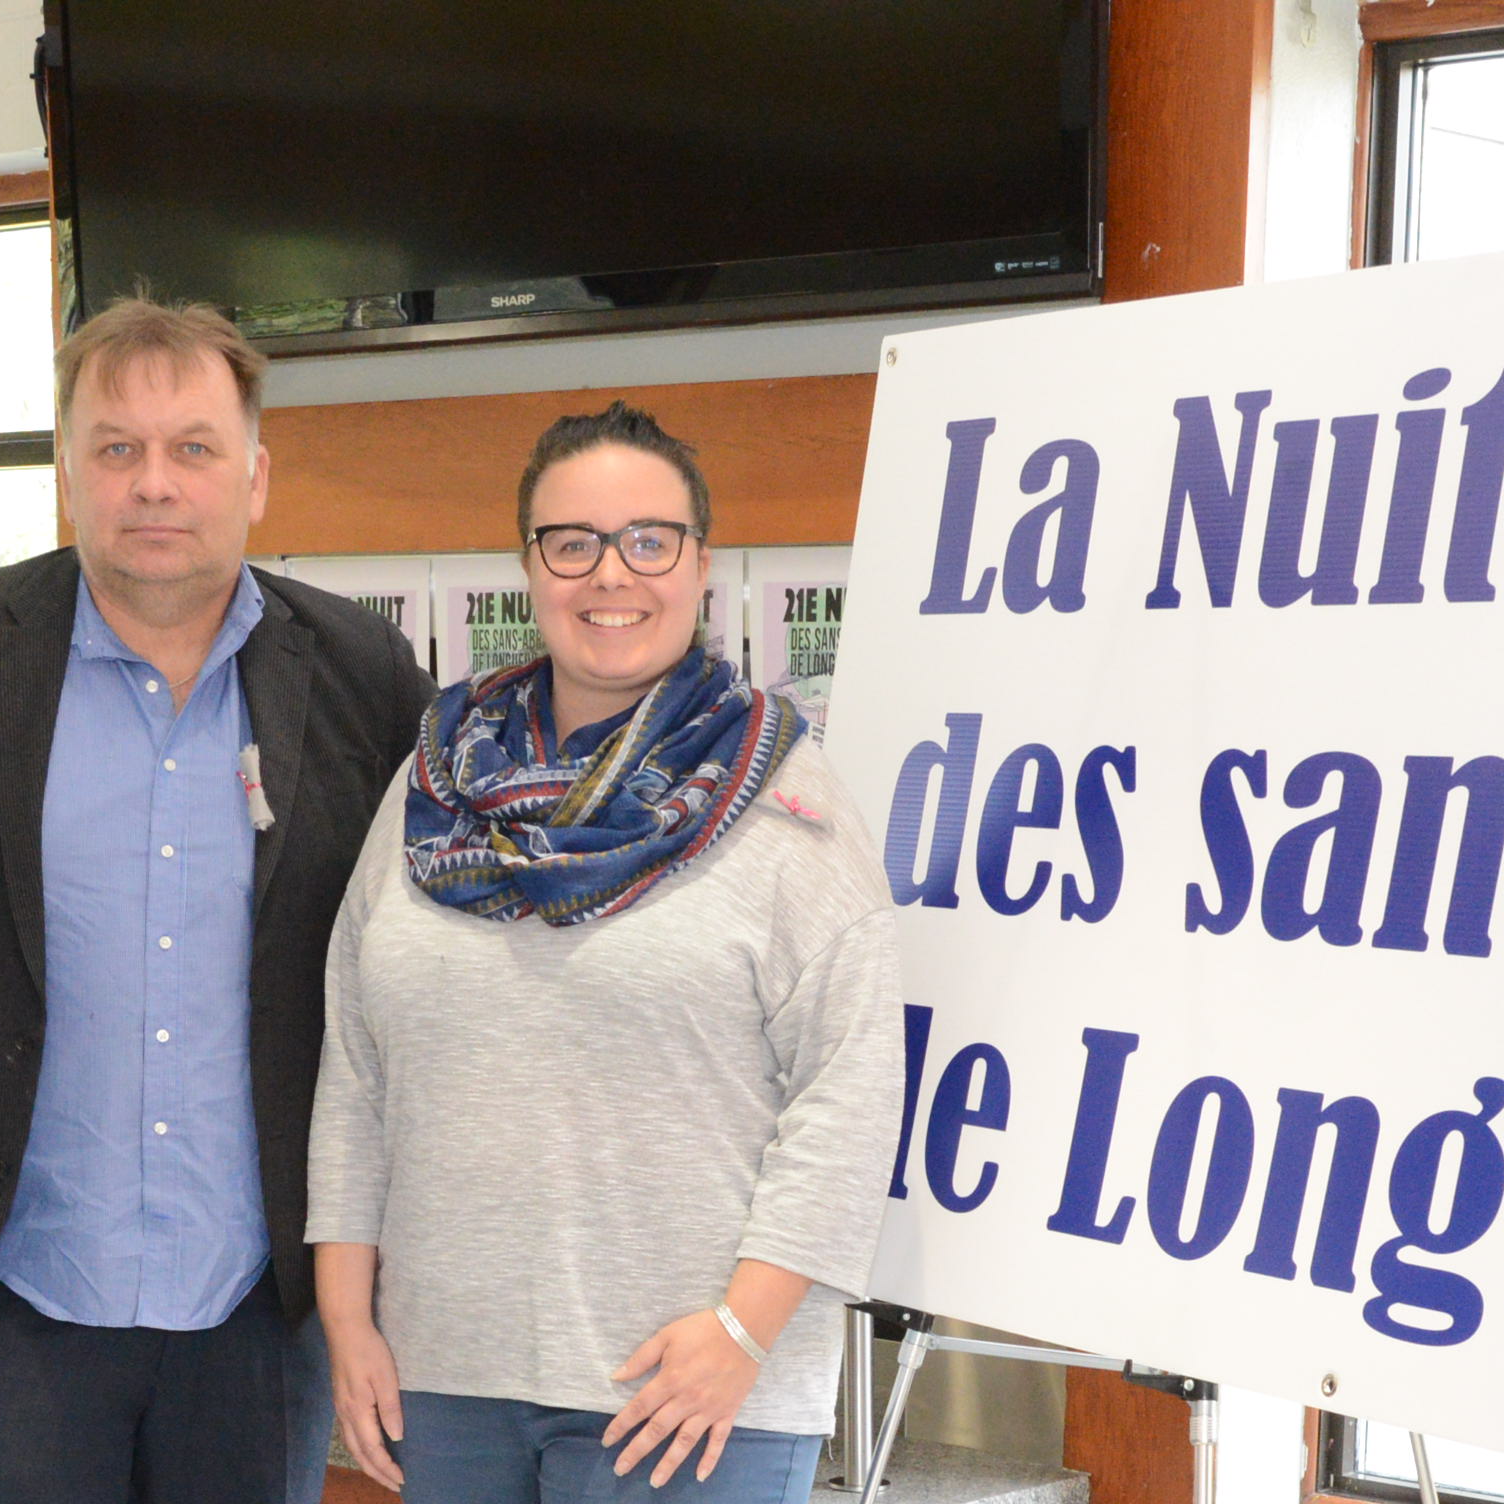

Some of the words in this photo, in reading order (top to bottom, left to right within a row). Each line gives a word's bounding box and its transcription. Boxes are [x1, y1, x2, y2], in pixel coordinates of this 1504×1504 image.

[491, 293, 535, 308] SHARP
[919, 417, 1100, 616] La
[465, 592, 495, 624] 21E
[783, 587, 819, 623] 21E
[472, 629, 490, 651] DES
[791, 627, 812, 651] DES
[790, 652, 804, 676] DE
[883, 712, 1137, 924] des
